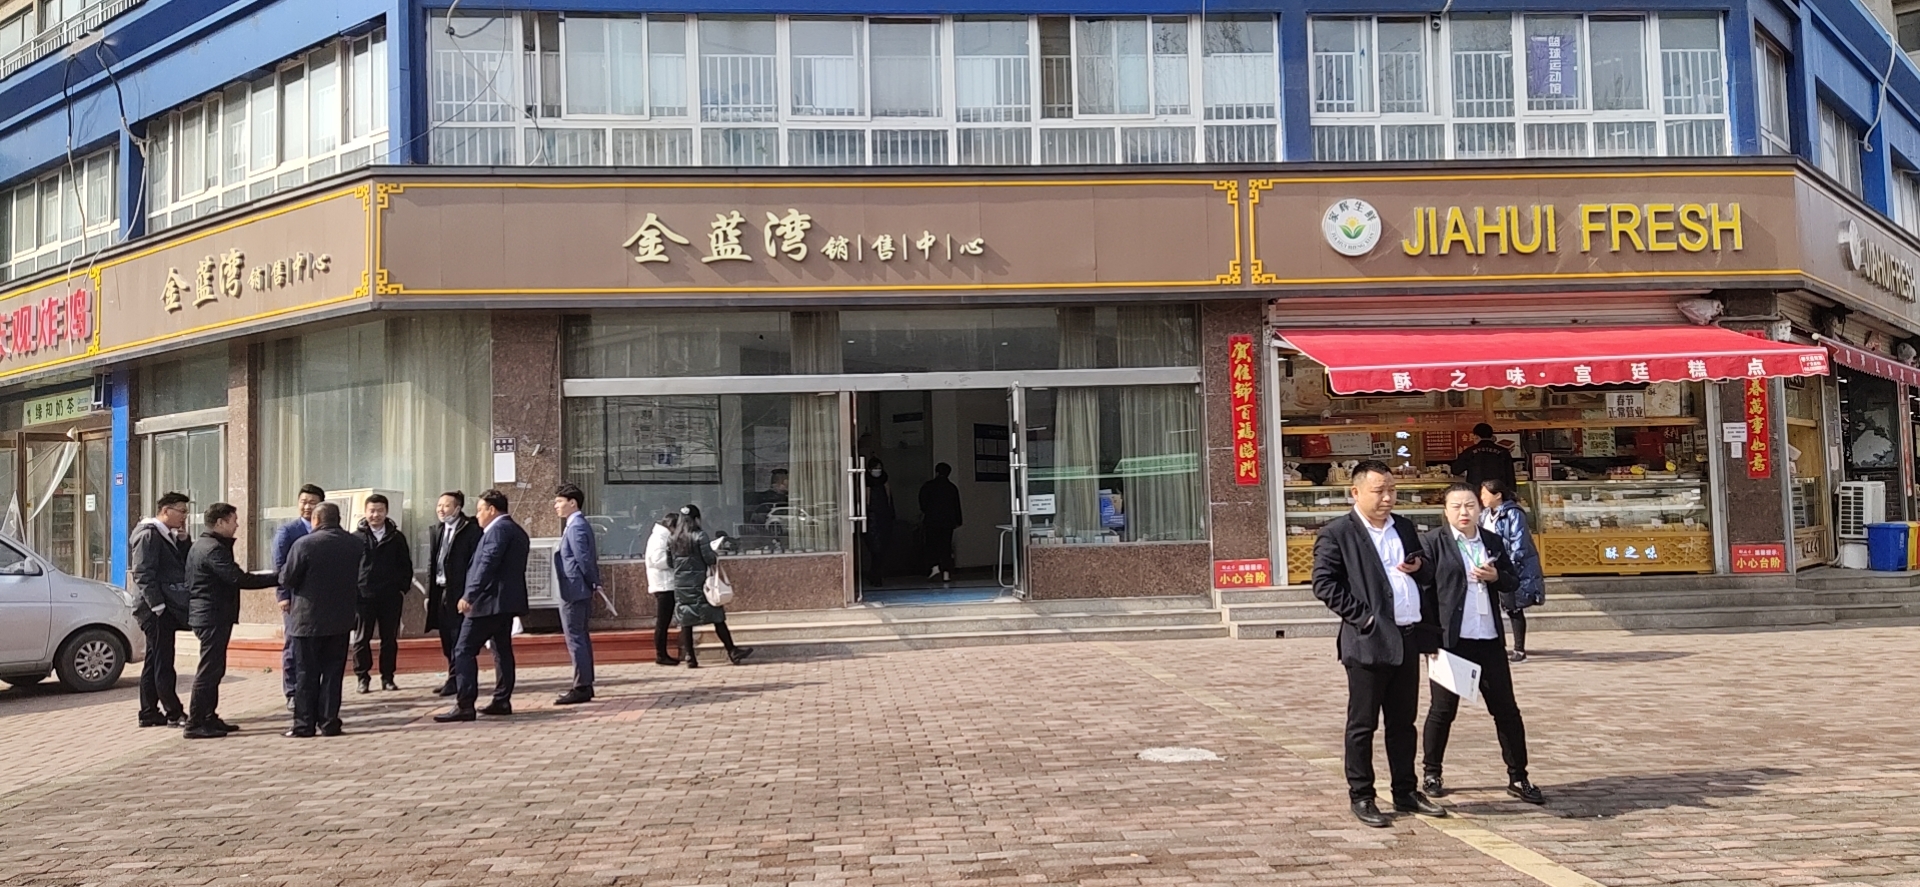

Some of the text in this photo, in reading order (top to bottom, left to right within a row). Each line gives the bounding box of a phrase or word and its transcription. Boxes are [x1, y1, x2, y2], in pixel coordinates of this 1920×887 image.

[622, 208, 811, 263] 金蓝湾
[1402, 203, 1743, 256] JIAHUI FRESH
[160, 247, 245, 312] 金蓝湾
[1616, 395, 1634, 406] 春节
[1608, 407, 1643, 418] 正常营业
[1604, 545, 1658, 559] 酥之味
[1736, 557, 1781, 569] 小心台阶
[1219, 571, 1267, 585] 小心台阶
